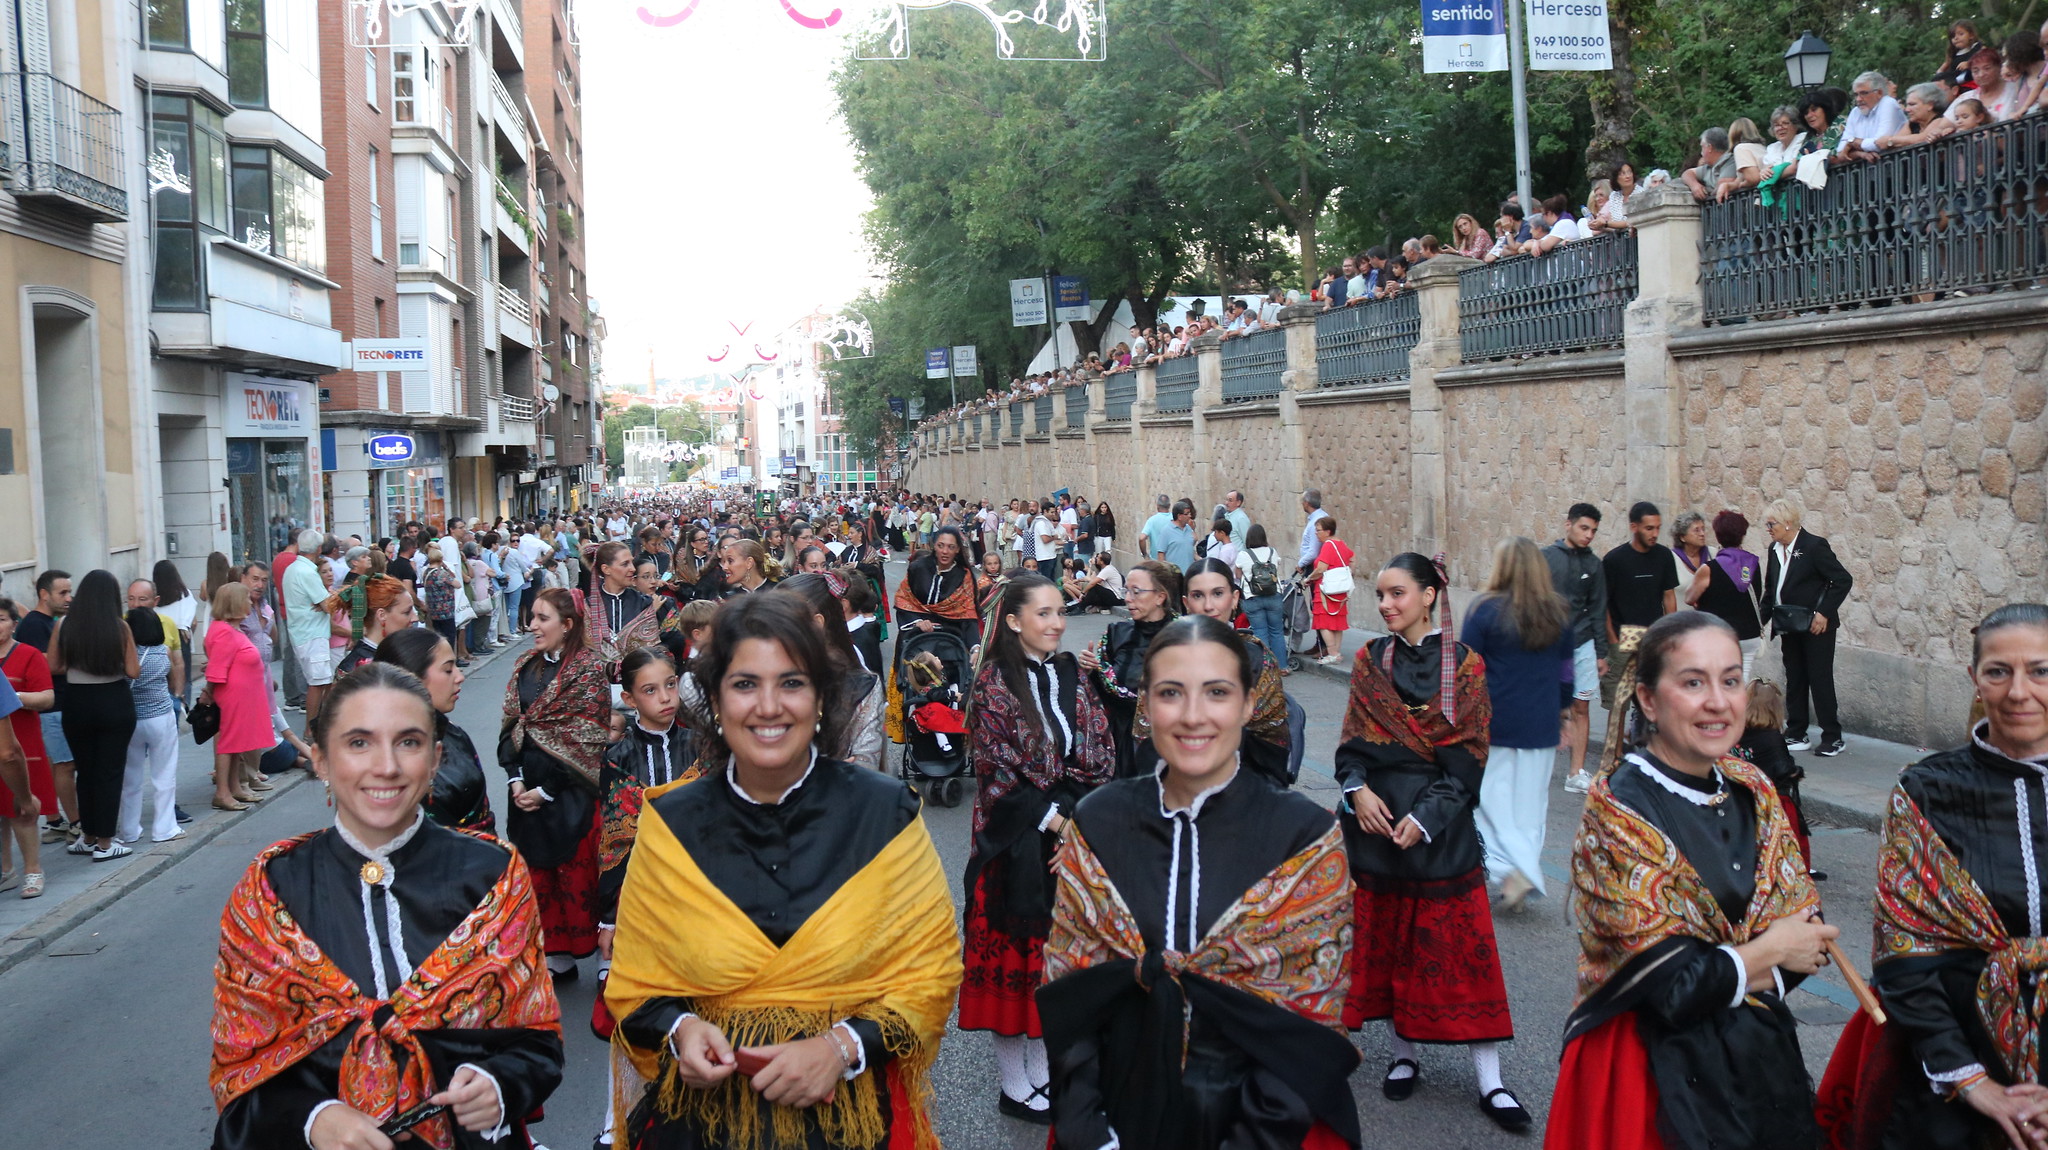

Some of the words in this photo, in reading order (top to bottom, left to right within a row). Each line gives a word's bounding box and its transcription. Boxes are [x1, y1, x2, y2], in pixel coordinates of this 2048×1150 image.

[1431, 5, 1493, 21] sentido
[1531, 0, 1603, 17] Hercesa
[1534, 36, 1556, 47] 949
[1559, 36, 1580, 46] 100
[1581, 36, 1604, 47] 500
[1535, 50, 1606, 60] hercesa.com
[1447, 59, 1484, 68] Hercesa
[1013, 297, 1044, 305] Hercesa
[358, 350, 423, 360] TECNORETE
[245, 389, 300, 422] TECNORETE
[375, 441, 409, 456] bed's
